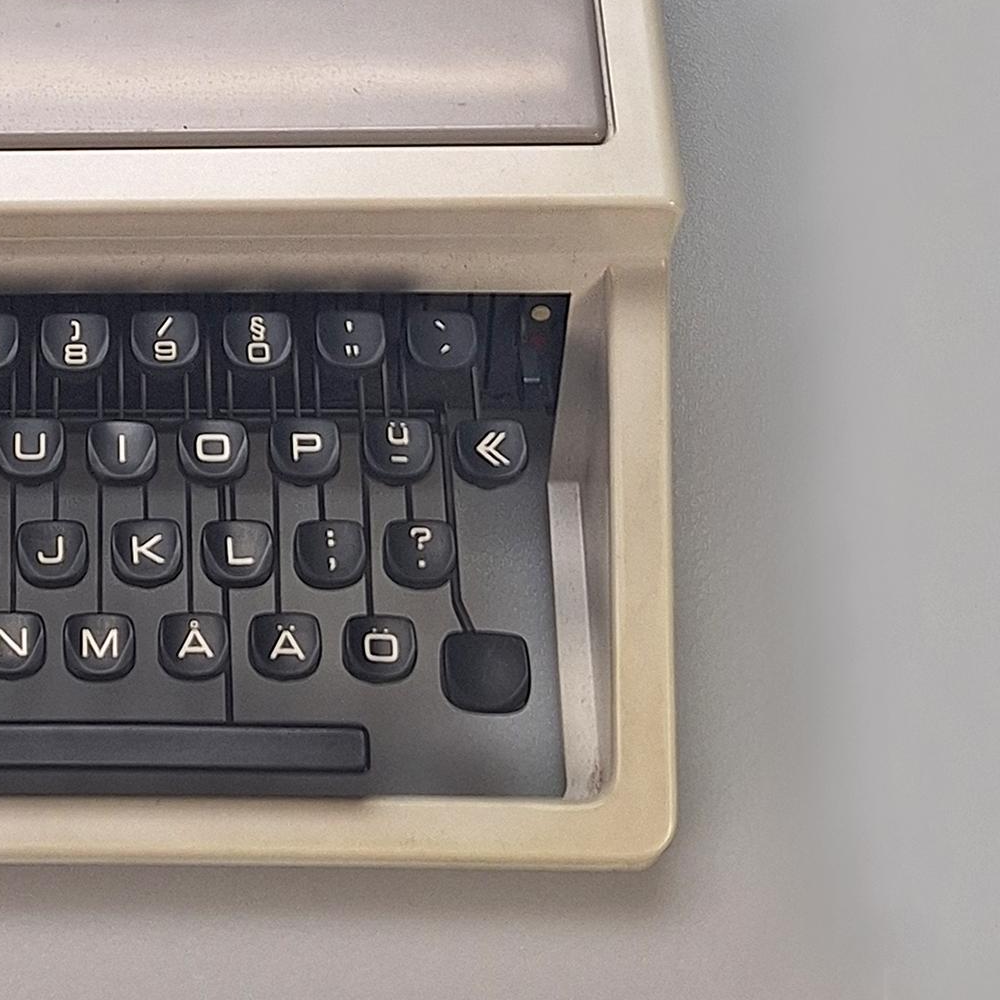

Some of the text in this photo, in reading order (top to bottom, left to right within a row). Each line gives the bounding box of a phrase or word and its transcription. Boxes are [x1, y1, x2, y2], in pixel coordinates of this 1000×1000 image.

[64, 344, 87, 364] 8
[154, 340, 177, 361] 9
[14, 432, 46, 460] U
[118, 434, 126, 463] I
[196, 433, 231, 462] O
[292, 433, 322, 461] P
[37, 535, 64, 564] J
[131, 534, 165, 564] K
[226, 537, 255, 565] L
[410, 526, 432, 550] ?
[82, 628, 118, 658] M
[178, 620, 214, 658] Å
[270, 624, 305, 660] Ä
[364, 627, 399, 662] Ö
